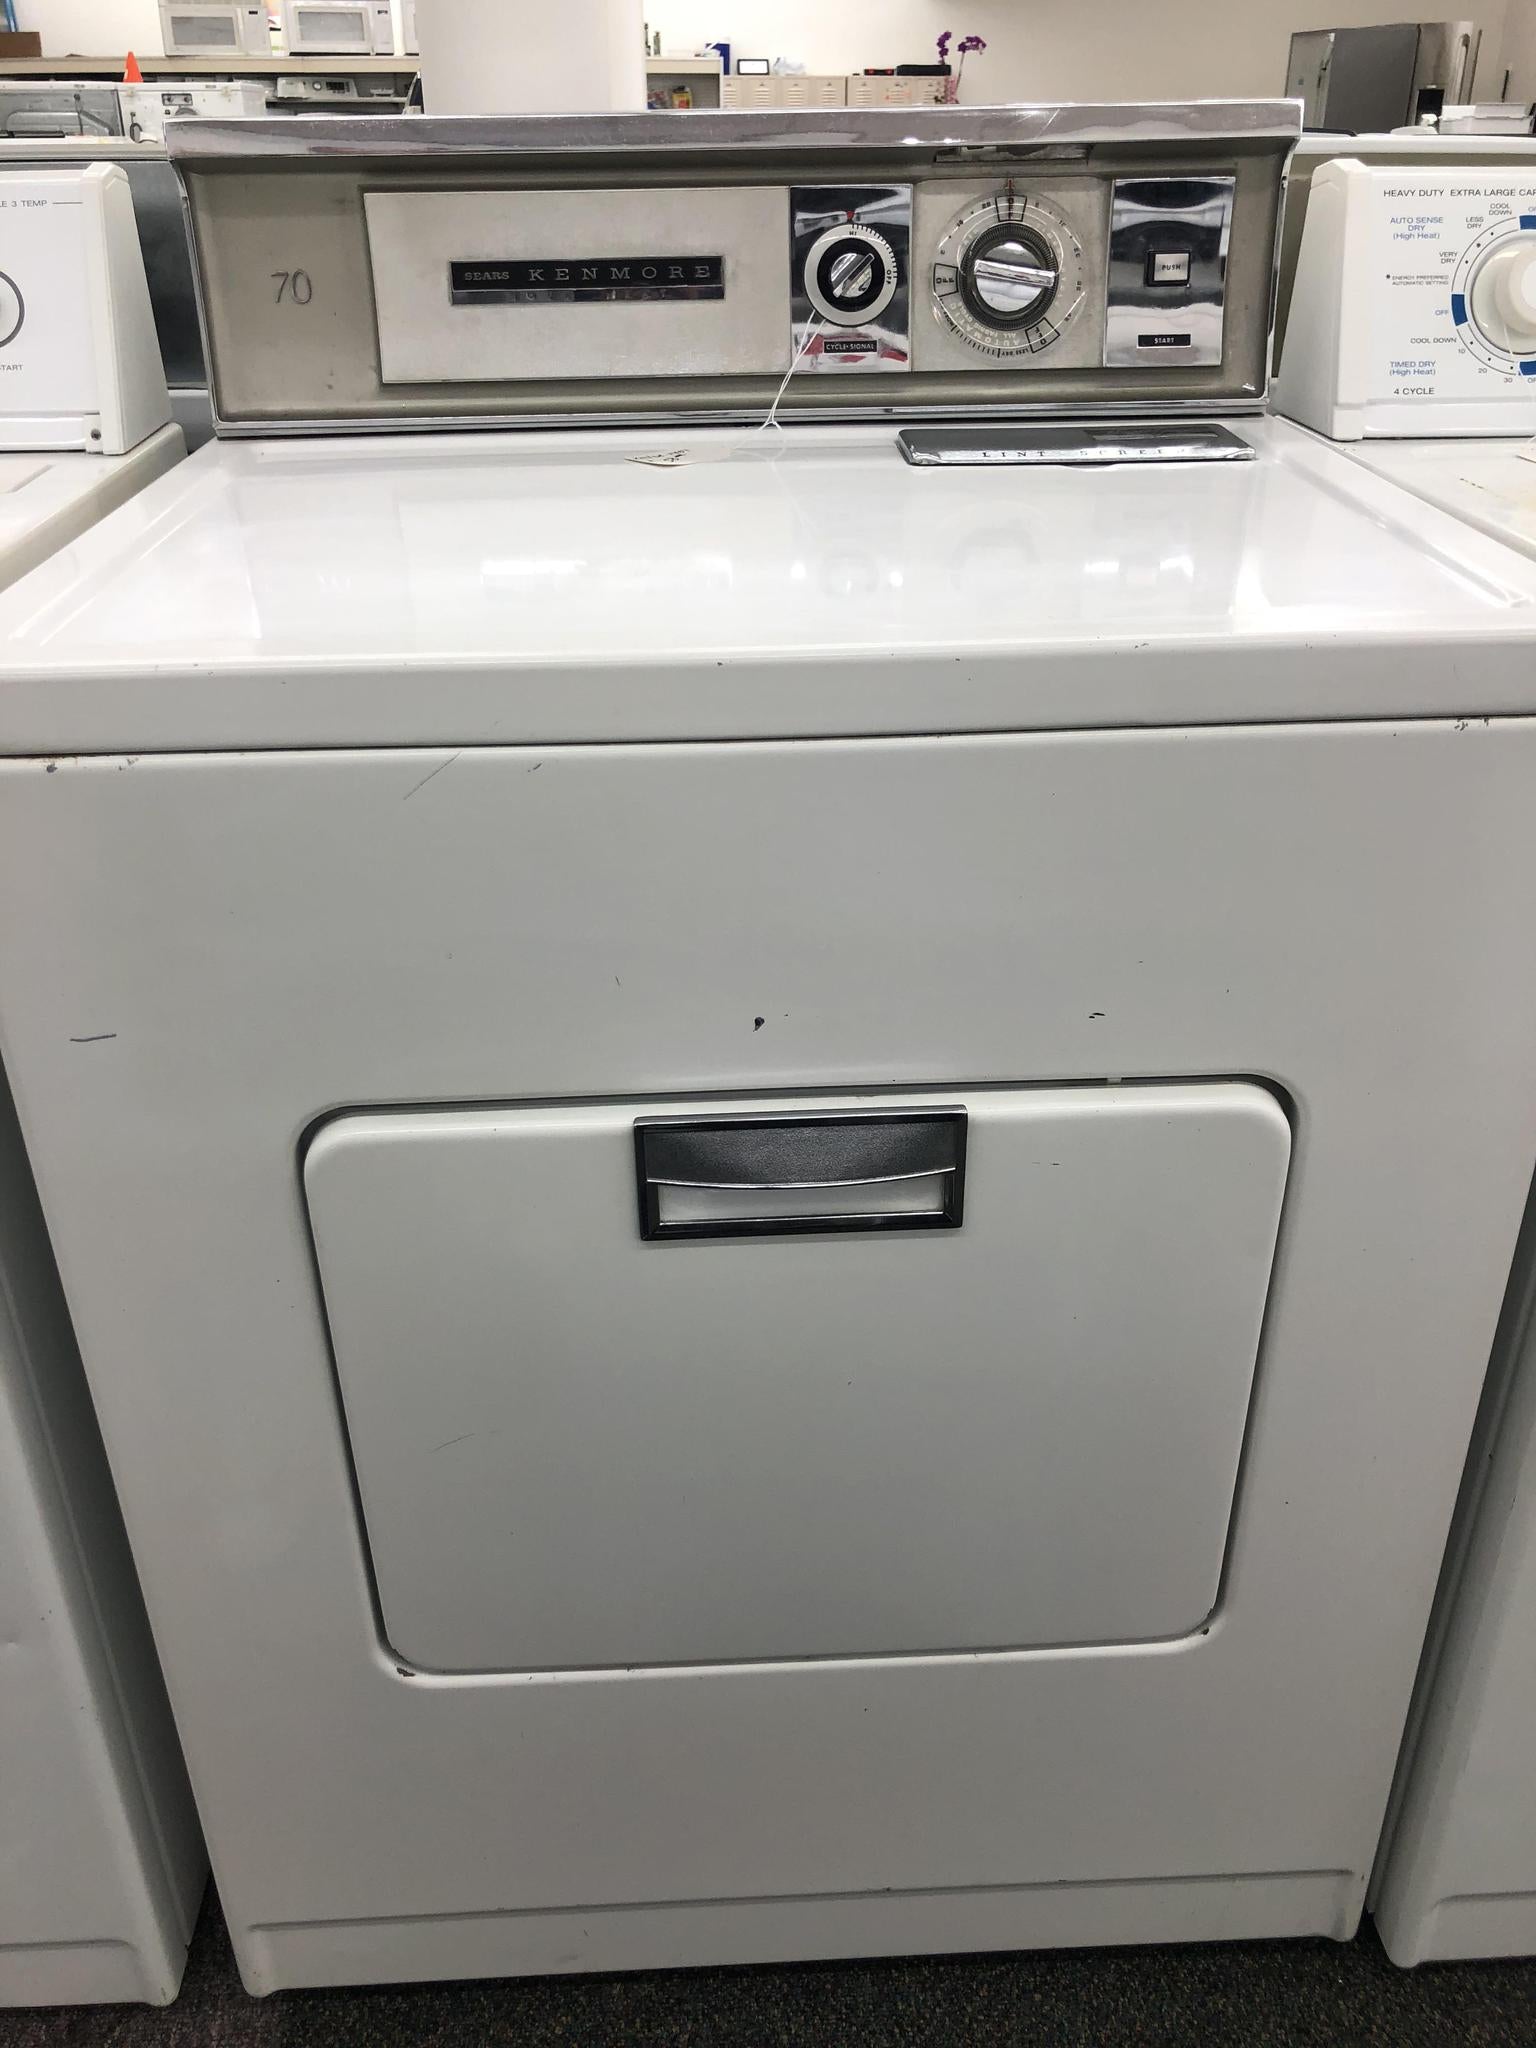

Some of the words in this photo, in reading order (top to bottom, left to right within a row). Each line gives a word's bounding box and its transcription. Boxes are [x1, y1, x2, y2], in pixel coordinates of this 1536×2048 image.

[1383, 189, 1415, 197] HEAVY
[1419, 189, 1444, 197] DUTY
[1484, 189, 1516, 197] LARGE
[11, 200, 18, 208] 3
[21, 199, 48, 207] TEMP
[1393, 232, 1415, 240] (High
[464, 271, 510, 281] SEARS
[528, 265, 711, 281] KENMORE
[885, 269, 893, 285] OFF
[271, 269, 312, 304] 70
[1034, 327, 1047, 345] OFF
[1390, 369, 1412, 377] (High
